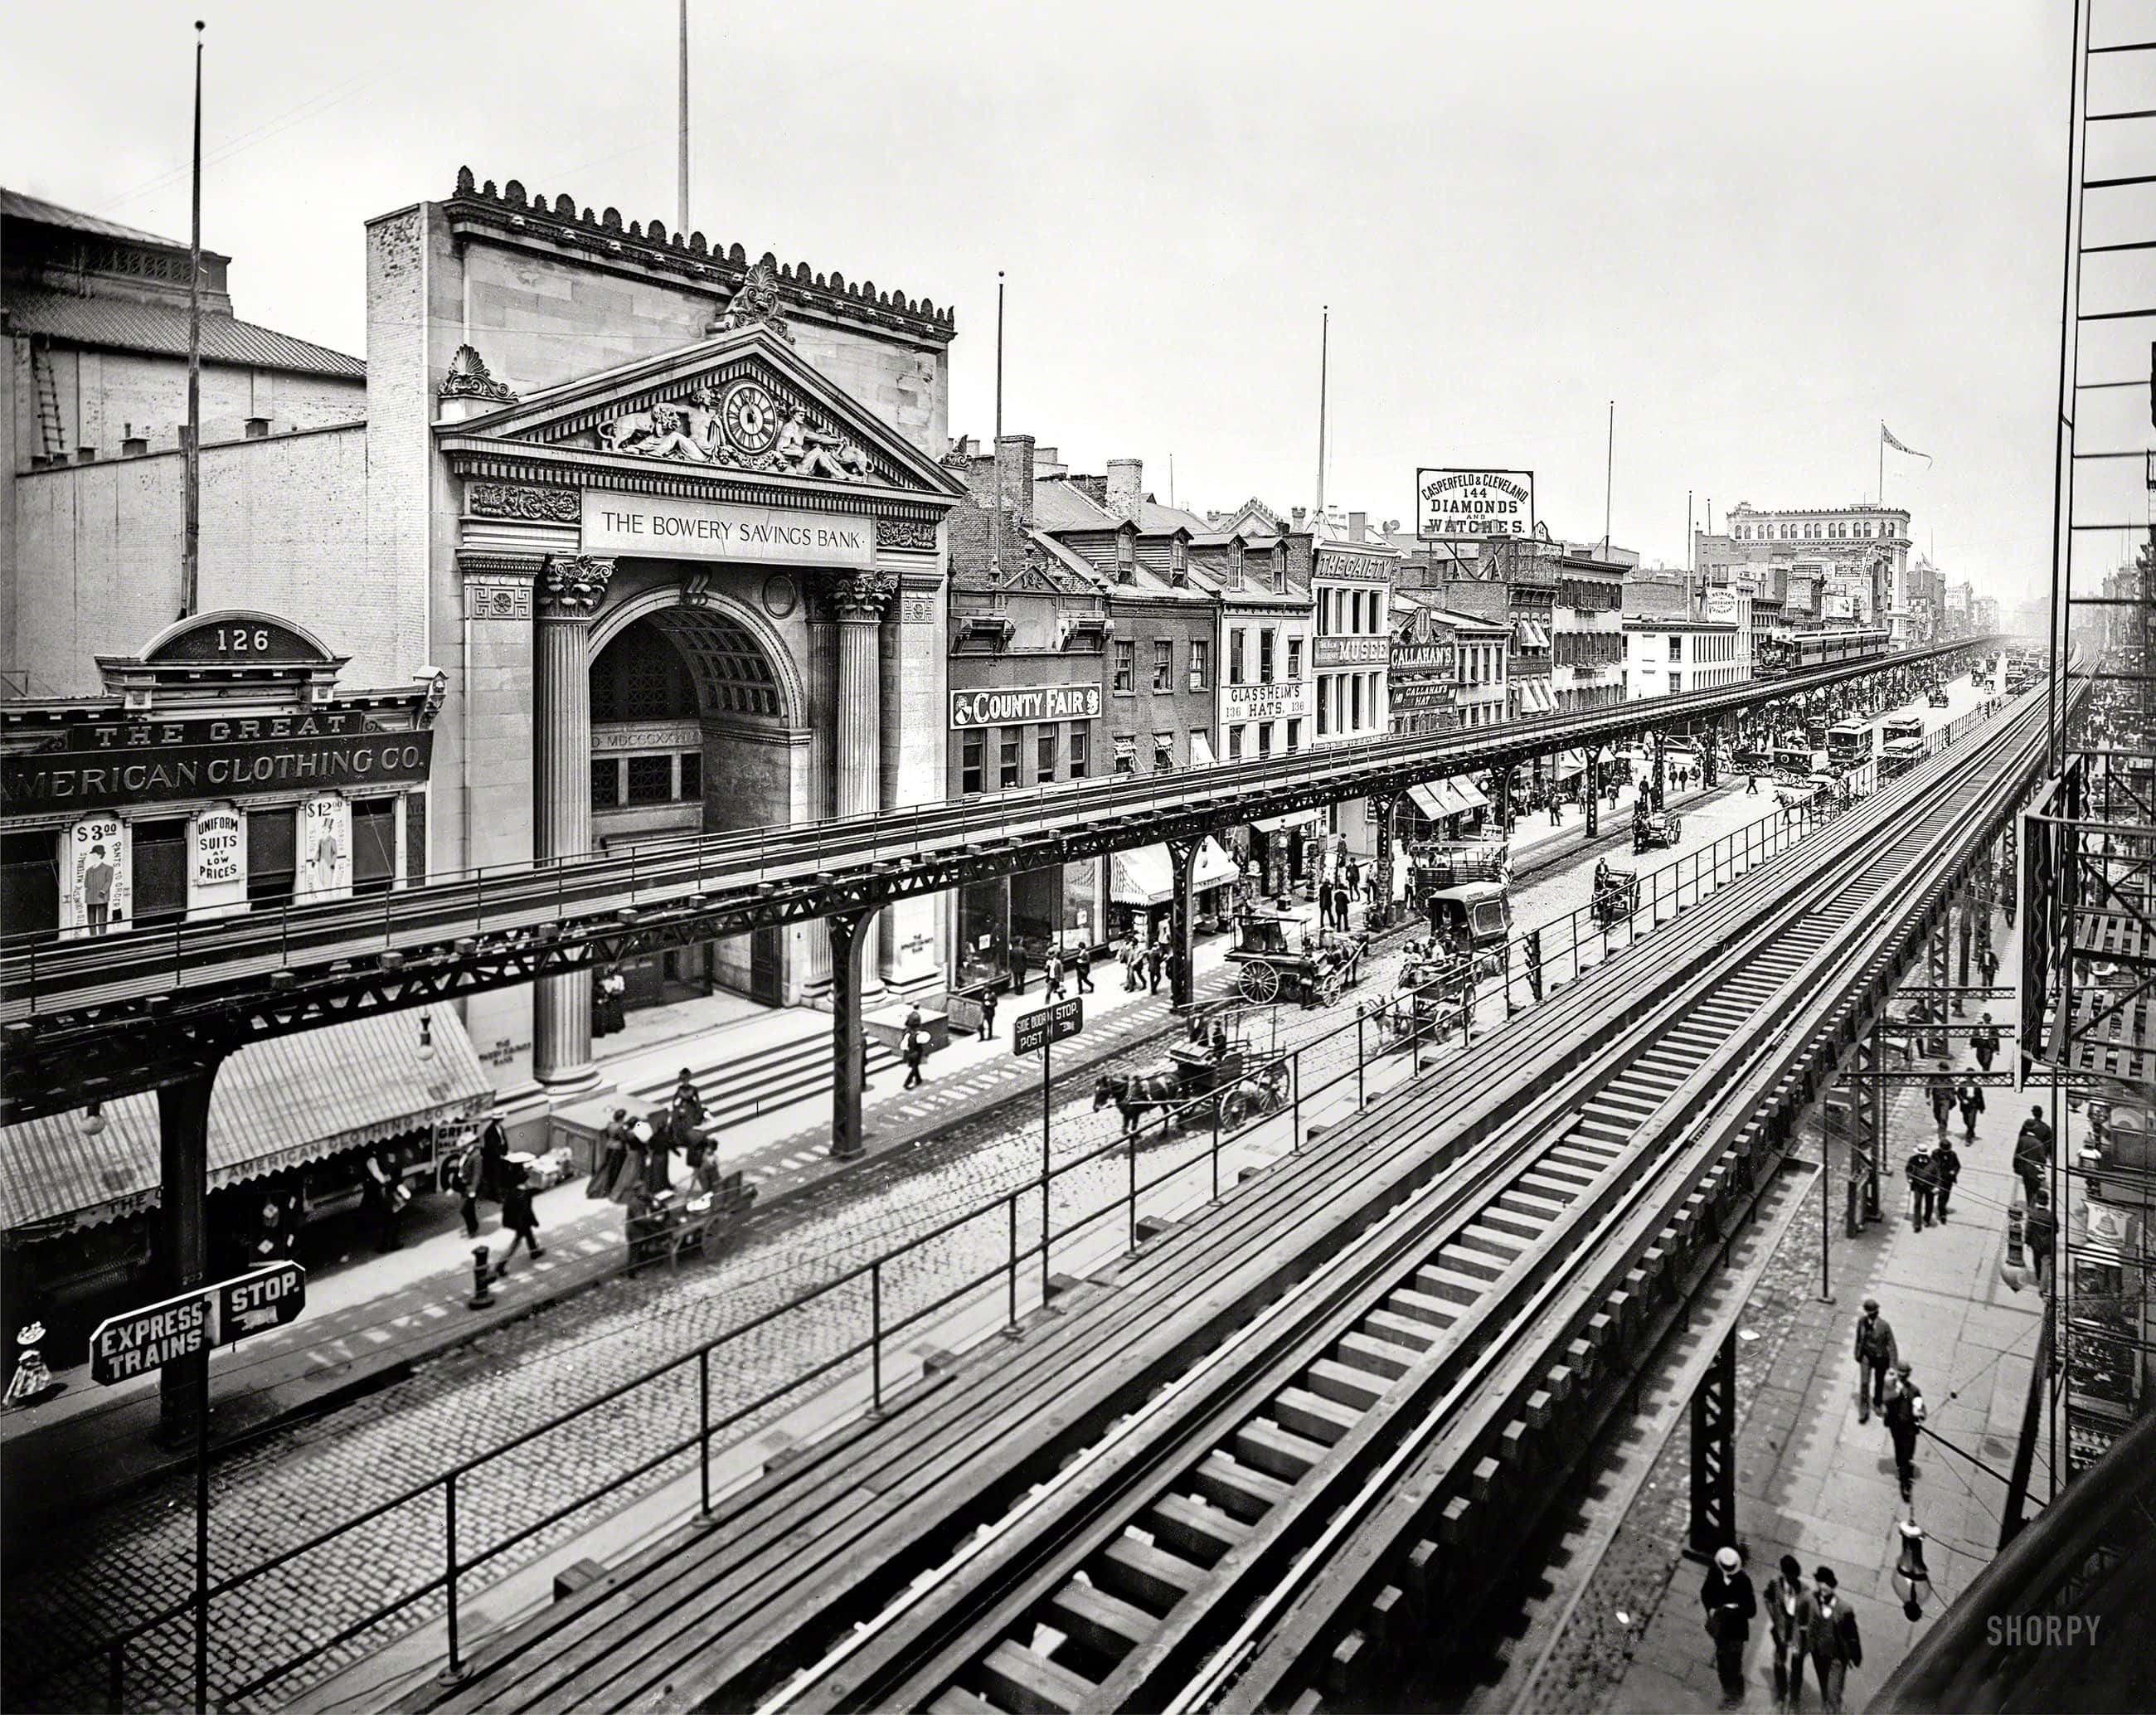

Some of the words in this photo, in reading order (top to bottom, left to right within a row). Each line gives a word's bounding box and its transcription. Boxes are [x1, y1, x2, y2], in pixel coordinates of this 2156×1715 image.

[1420, 474, 1474, 501] CASPERFELD
[1475, 476, 1481, 486] &
[1464, 488, 1488, 498] 144
[1431, 499, 1517, 513] DIAMONDS
[601, 511, 644, 534] THE
[653, 516, 732, 540] BOWERY
[740, 523, 811, 546] SAVINGS
[1319, 554, 1345, 576] THE
[1344, 556, 1391, 579] GAIETY
[217, 629, 269, 651] 126
[1231, 685, 1300, 702] GLASSHEIM'S
[1414, 695, 1431, 707] HAT
[973, 692, 1043, 724] COUNTY
[1046, 689, 1084, 718] FAIR
[1226, 707, 1241, 717] 136
[95, 723, 185, 747] THE
[209, 715, 346, 742] GREAT
[207, 748, 373, 784] CLOTHING
[381, 746, 425, 772] CO.
[198, 816, 239, 835] UNIFORM
[199, 834, 238, 851] SUITS
[110, 841, 122, 867] PANTS
[206, 856, 230, 866] LOW
[199, 863, 238, 880] PRICES
[1020, 1031, 1043, 1050] POST
[227, 1143, 322, 1179] AMERICAN
[328, 1115, 414, 1150] CLOTHING
[107, 1193, 147, 1215] THE
[231, 1270, 300, 1314] STOP.
[100, 1301, 203, 1358] EXPRESS
[108, 1329, 203, 1380] TRAINS
